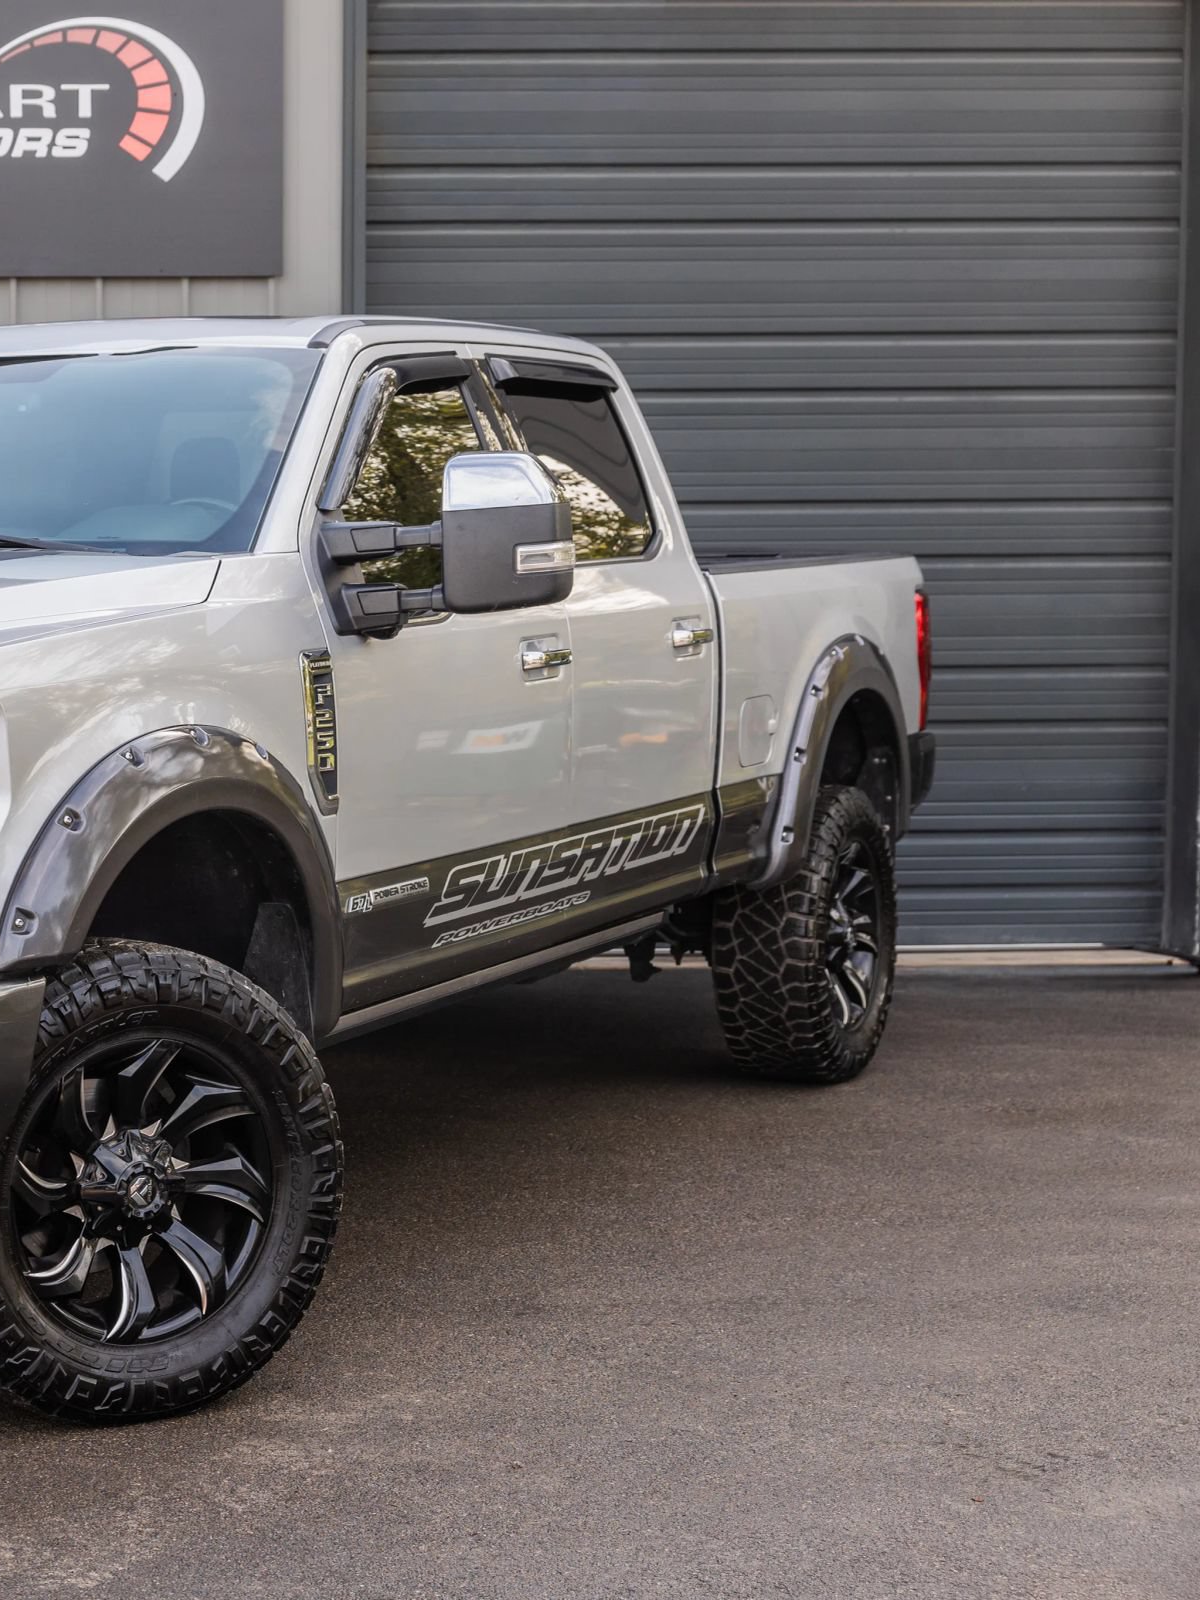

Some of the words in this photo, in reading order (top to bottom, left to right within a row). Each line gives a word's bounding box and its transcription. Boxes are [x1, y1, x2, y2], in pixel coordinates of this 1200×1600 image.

[374, 887, 400, 900] POWER
[400, 880, 429, 894] STROKE
[423, 803, 705, 928] SUNSATION
[431, 890, 591, 948] POWERBOATS
